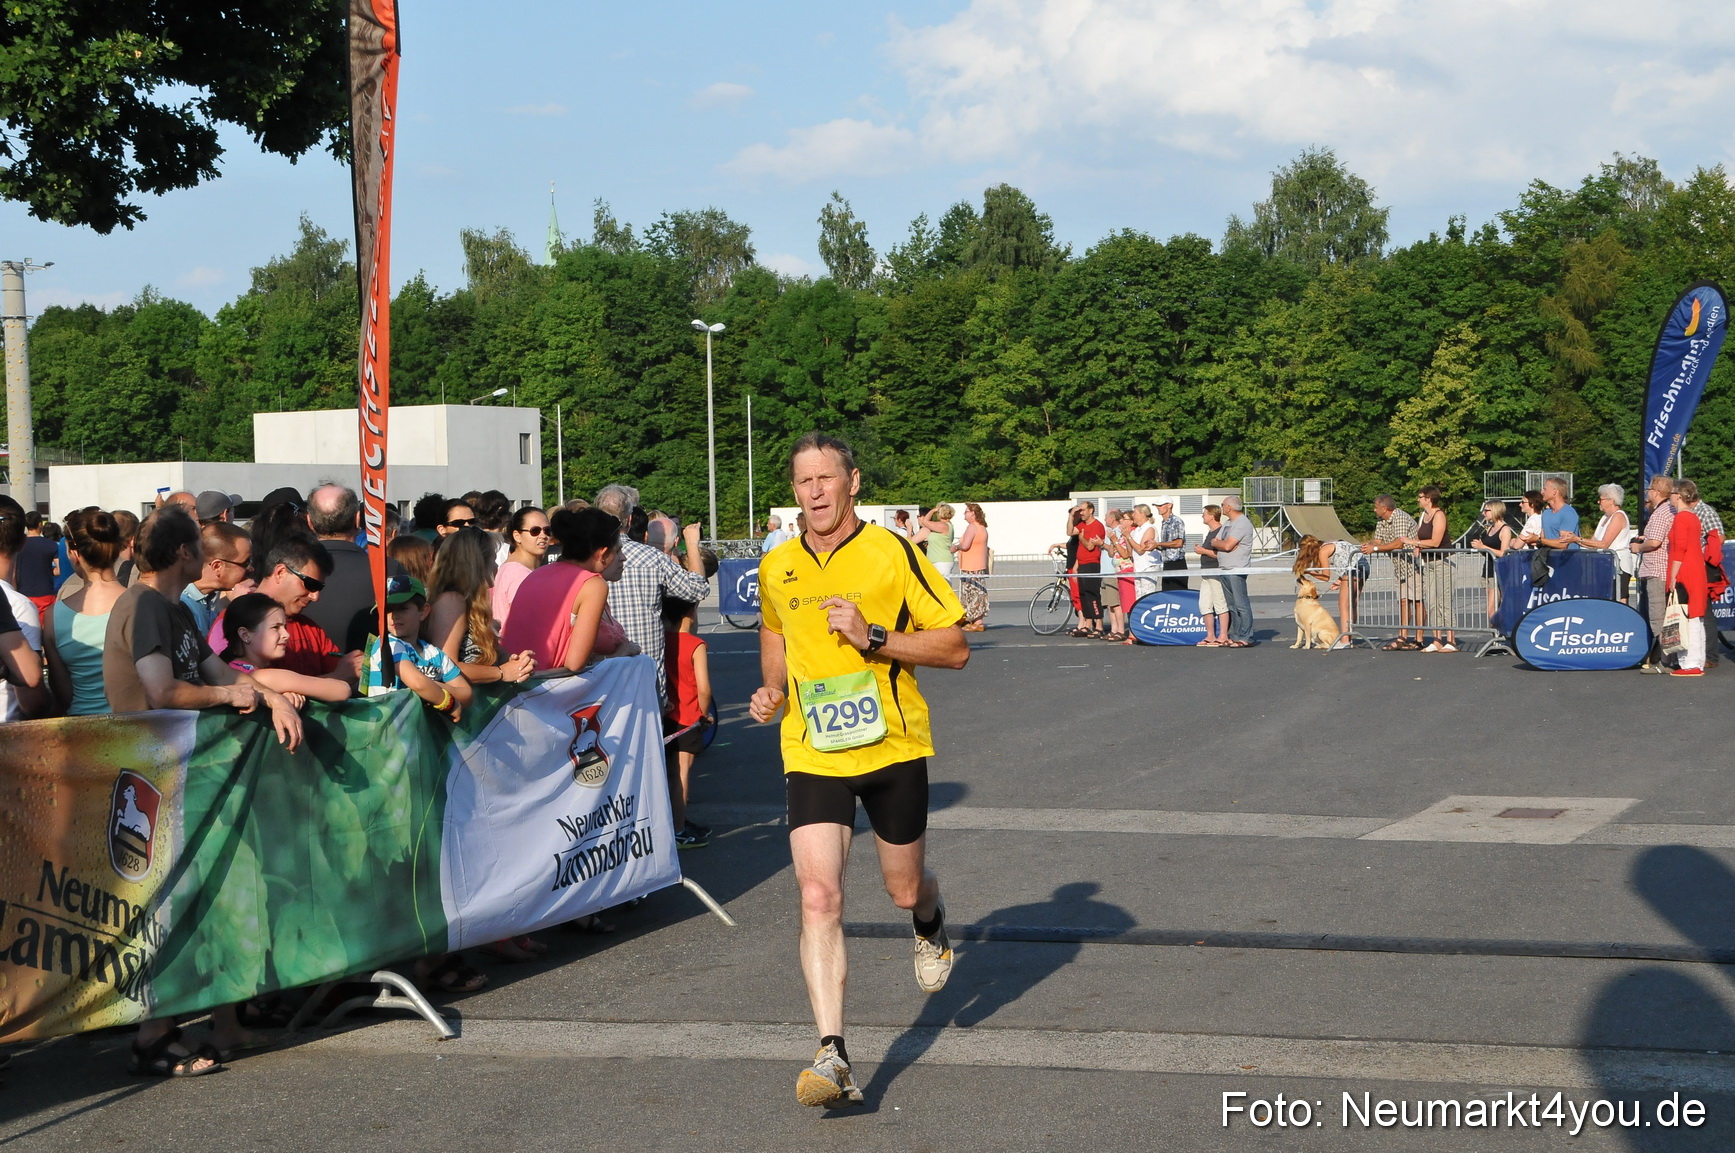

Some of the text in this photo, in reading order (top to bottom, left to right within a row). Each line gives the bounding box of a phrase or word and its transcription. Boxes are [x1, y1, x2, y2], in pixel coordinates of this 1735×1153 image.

[1549, 629, 1634, 647] Fischer
[1558, 646, 1628, 655] AUTOMOBILE
[807, 696, 879, 734] 1299
[581, 766, 605, 784] 1628
[556, 793, 635, 841] Neumarkter
[117, 852, 140, 873] 1628
[551, 820, 654, 891] Lammsbräu
